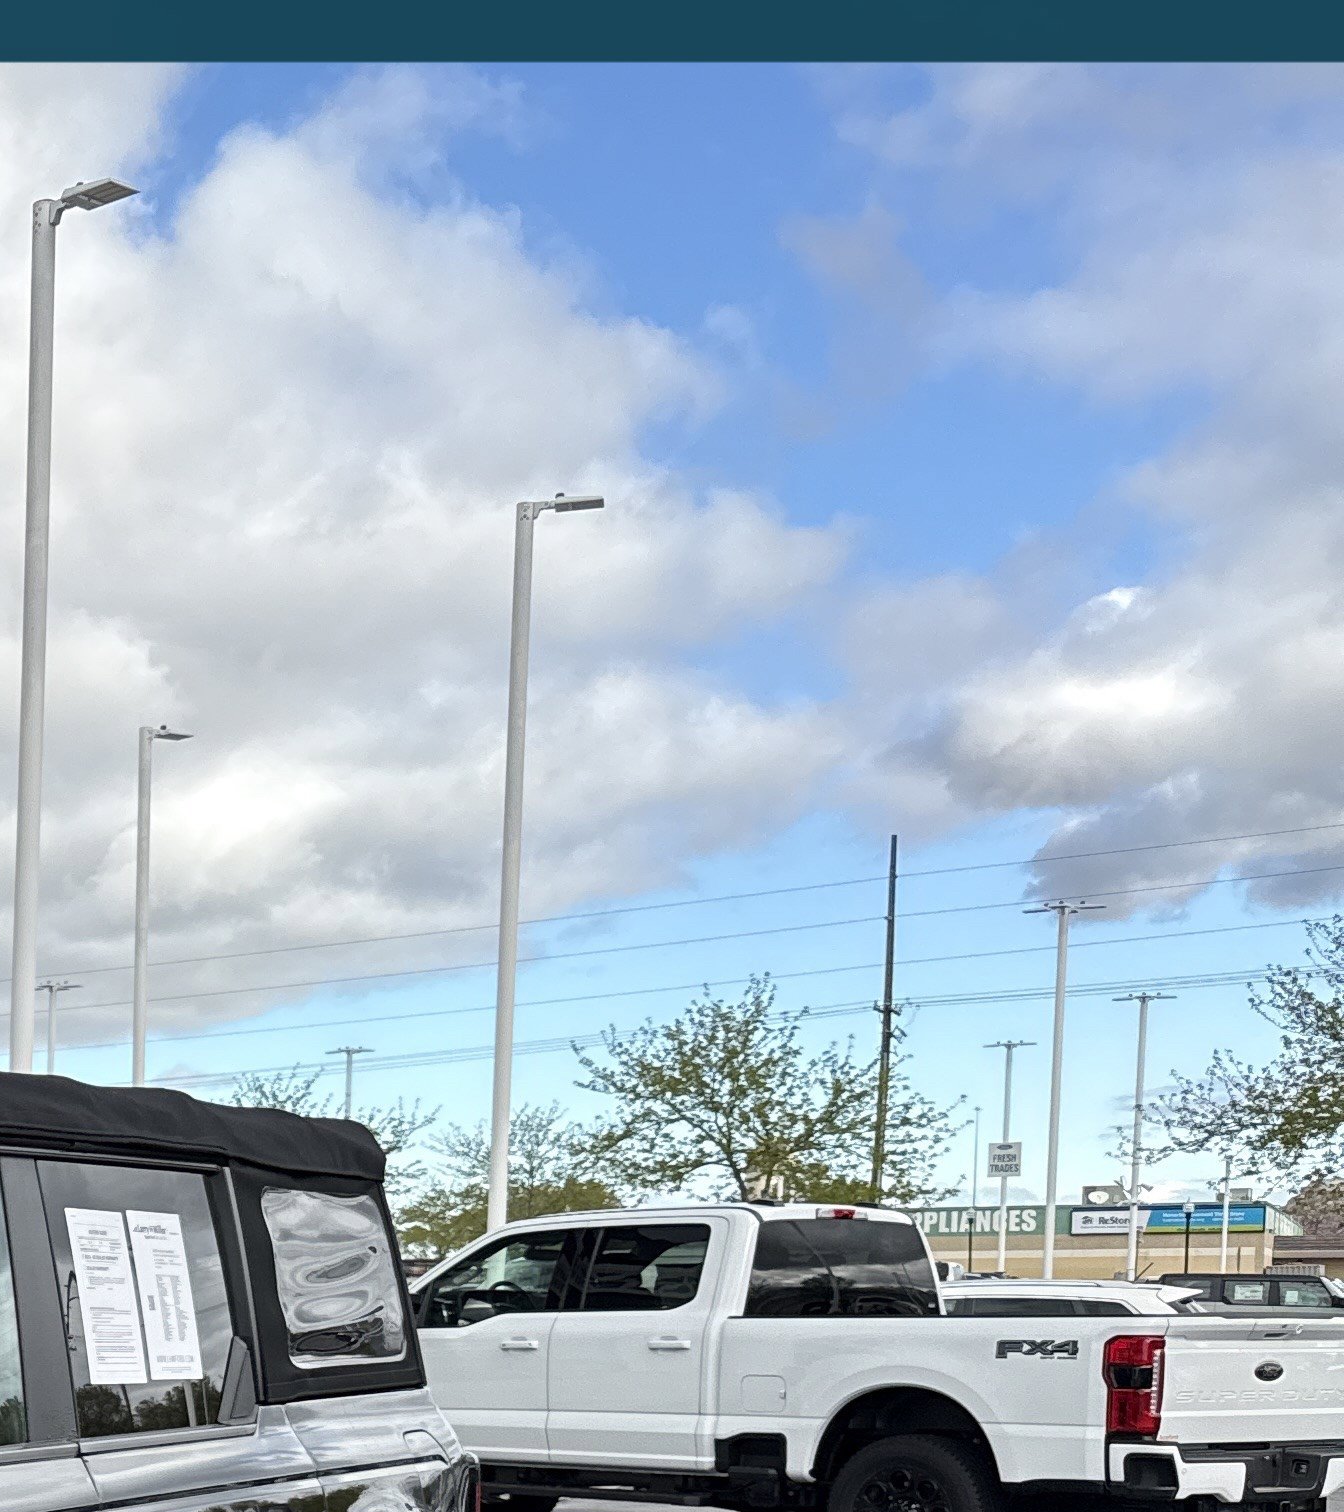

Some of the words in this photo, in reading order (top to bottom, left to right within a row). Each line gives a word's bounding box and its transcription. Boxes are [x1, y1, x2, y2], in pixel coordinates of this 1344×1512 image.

[992, 1153, 1017, 1163] FRESH
[989, 1164, 1020, 1174] TRADES
[1098, 1215, 1131, 1226] ReStor
[995, 1339, 1079, 1359] FX4
